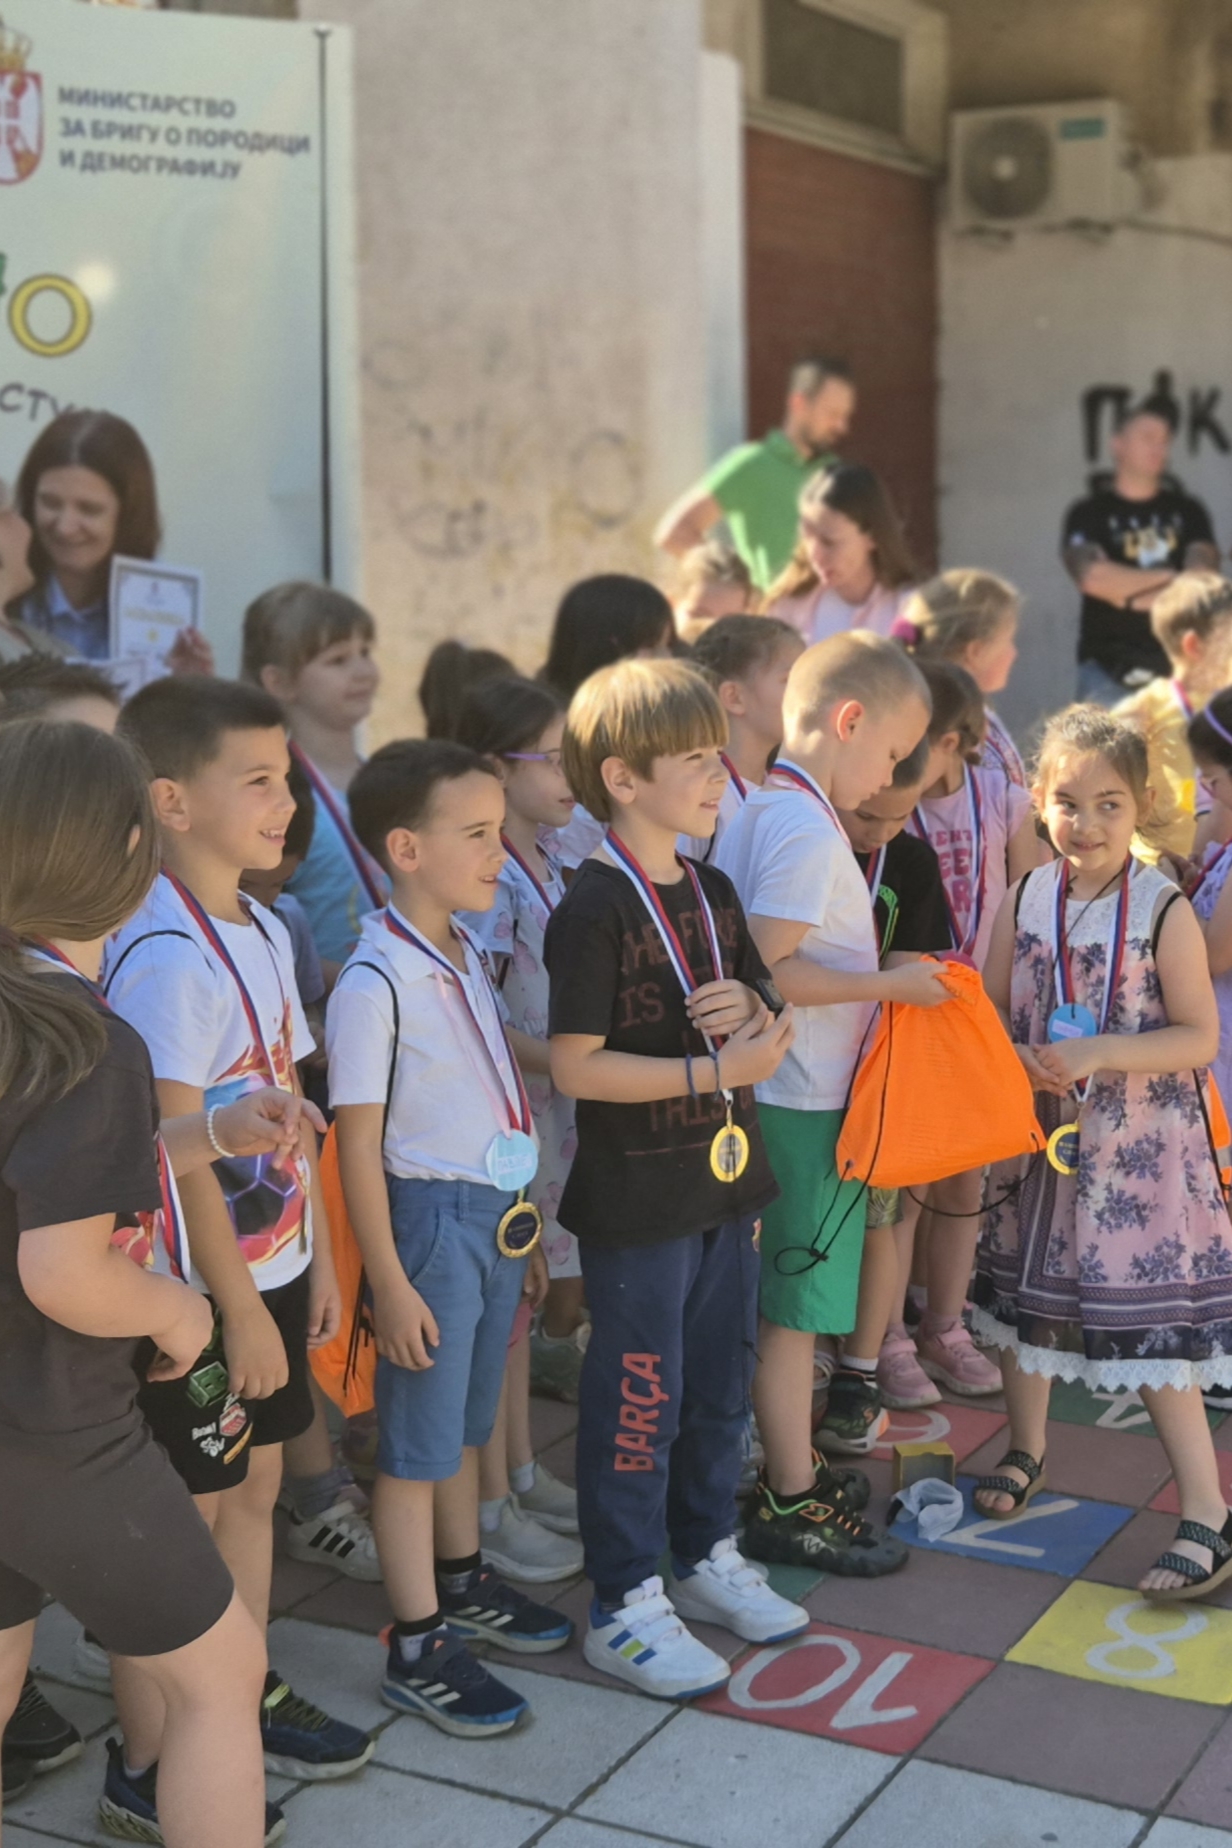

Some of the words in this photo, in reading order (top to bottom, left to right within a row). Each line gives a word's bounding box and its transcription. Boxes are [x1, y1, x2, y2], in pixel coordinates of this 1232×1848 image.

[58, 86, 236, 119] МИНИСТАРСТВО
[60, 119, 85, 138] ЗА
[90, 121, 159, 146] БРИГУ
[165, 128, 181, 147] О
[186, 130, 311, 156] ПОРОДИЦИ
[59, 149, 75, 168] И
[80, 151, 242, 180] ДЕМОГРАФИЈУ
[618, 981, 665, 1029] IS
[613, 1352, 670, 1471] BARÇA
[1084, 1600, 1209, 1679] 8
[727, 1633, 919, 1730] 10
